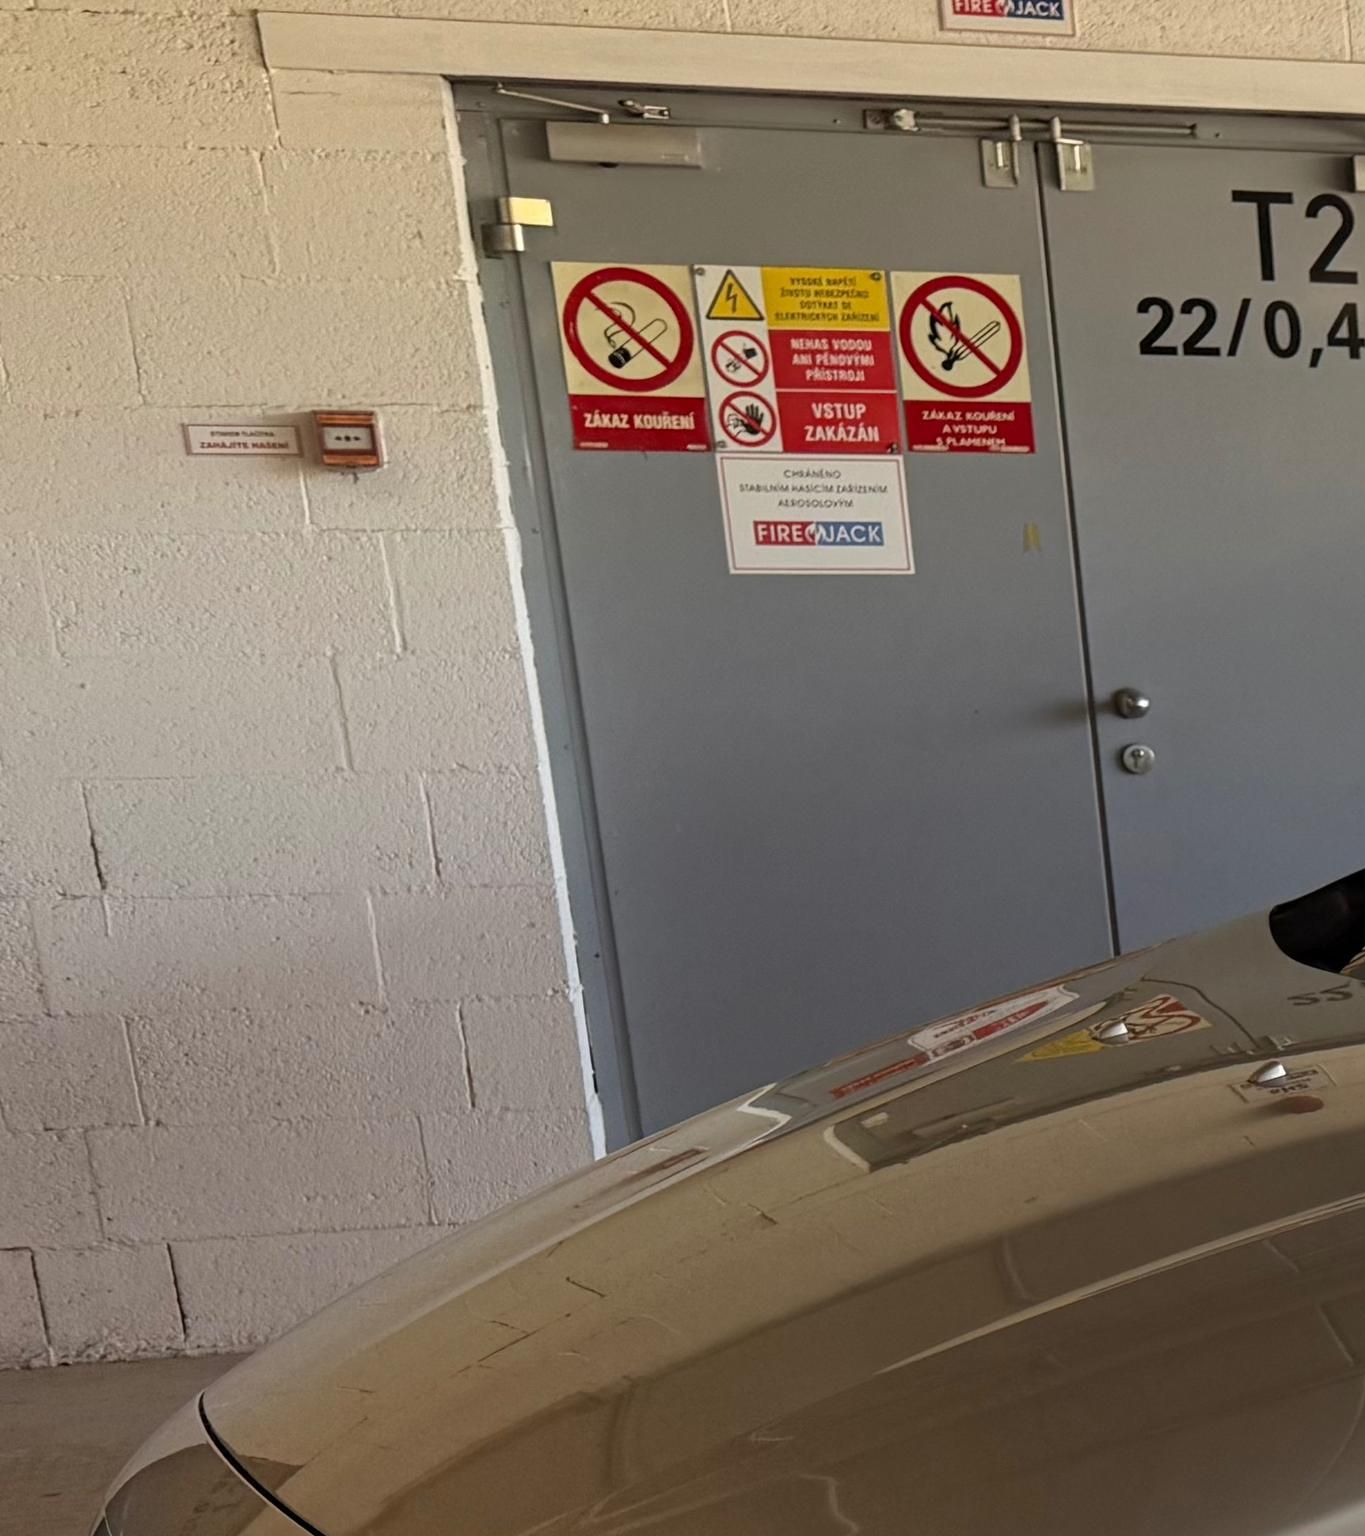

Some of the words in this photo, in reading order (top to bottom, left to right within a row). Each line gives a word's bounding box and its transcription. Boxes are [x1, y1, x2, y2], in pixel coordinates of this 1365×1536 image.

[1016, 0, 1061, 17] JACK
[1232, 190, 1358, 284] T2
[790, 338, 829, 350] NEHAS
[832, 339, 872, 351] VODOU
[792, 354, 812, 366] ANI
[816, 352, 874, 366] PĚNOVÝMI
[805, 367, 865, 381] PŘÍSTROJI
[811, 403, 866, 419] VSTUP
[921, 408, 962, 420] ZÁKAZ
[965, 410, 1015, 421] KOUŘENÍ
[584, 410, 630, 428] ZÁKAZ
[633, 411, 695, 430] KOUŘENÍ
[804, 422, 880, 442] ZAKÁZÁN
[942, 424, 950, 434] A
[953, 424, 998, 434] VSTUPU
[935, 437, 943, 446] S
[946, 437, 1006, 447] PLAMENEM
[757, 524, 801, 542] FIRE
[823, 525, 882, 543] JACK
